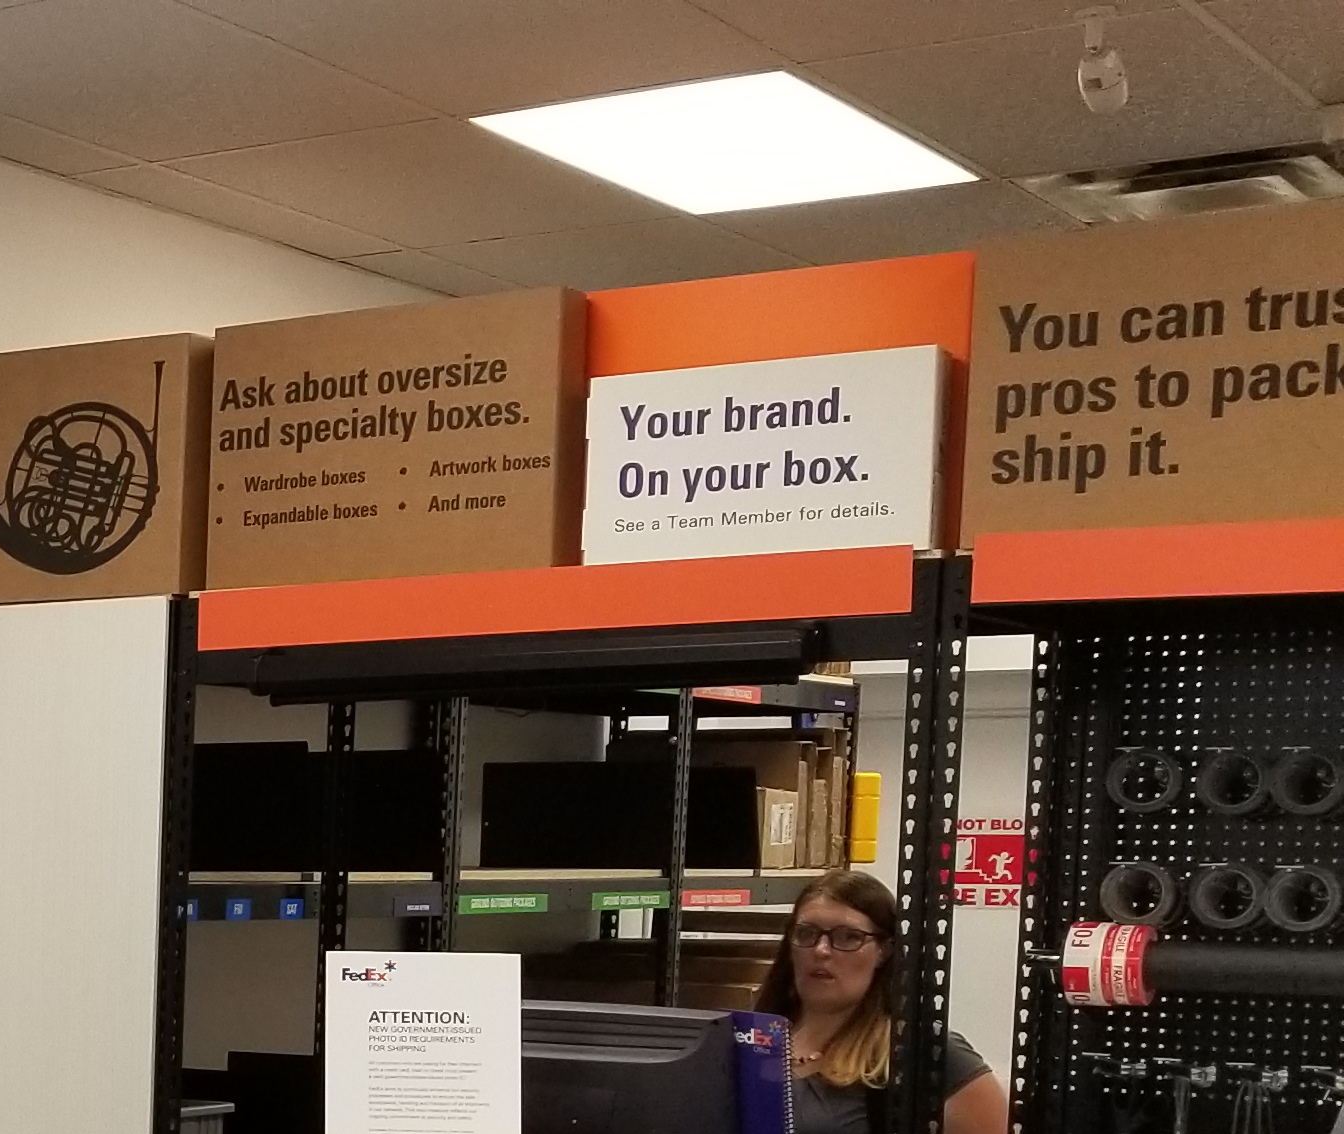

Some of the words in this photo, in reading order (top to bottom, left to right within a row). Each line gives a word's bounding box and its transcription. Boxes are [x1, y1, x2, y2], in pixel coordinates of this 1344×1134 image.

[999, 302, 1099, 354] You
[1119, 298, 1224, 344] can
[219, 375, 276, 411] Ask
[284, 368, 369, 405] about
[376, 354, 507, 396] oversize
[995, 373, 1118, 433] pros
[1135, 364, 1190, 409] to
[218, 418, 271, 453] and
[279, 404, 417, 450] specialty
[427, 397, 530, 433] boxes.
[619, 401, 712, 442] Your
[722, 387, 852, 432] brand.
[429, 456, 497, 478] Artwork
[502, 453, 551, 473] boxes
[990, 430, 1107, 493] ship
[1127, 427, 1180, 476] it.
[244, 472, 316, 494] Wardrobe
[320, 468, 366, 489] boxes
[617, 461, 670, 500] On
[682, 455, 772, 503] your
[782, 447, 870, 487] box.
[242, 507, 328, 530] Expandable
[332, 501, 378, 521] boxes
[427, 493, 461, 514] And
[464, 492, 506, 510] more
[614, 517, 645, 534] See
[651, 519, 662, 532] a
[667, 514, 714, 531] Team
[721, 507, 792, 526] Member
[799, 503, 824, 521] for
[830, 499, 896, 519] details.
[341, 967, 388, 982] FedEx
[368, 1010, 471, 1025] ATTENTION:
[390, 1026, 482, 1034] GOVERNMENT-ISSUED
[368, 1035, 397, 1043] PHOTO
[409, 1036, 475, 1044] REQUIREMENTS
[387, 1045, 427, 1053] SHIPPING
